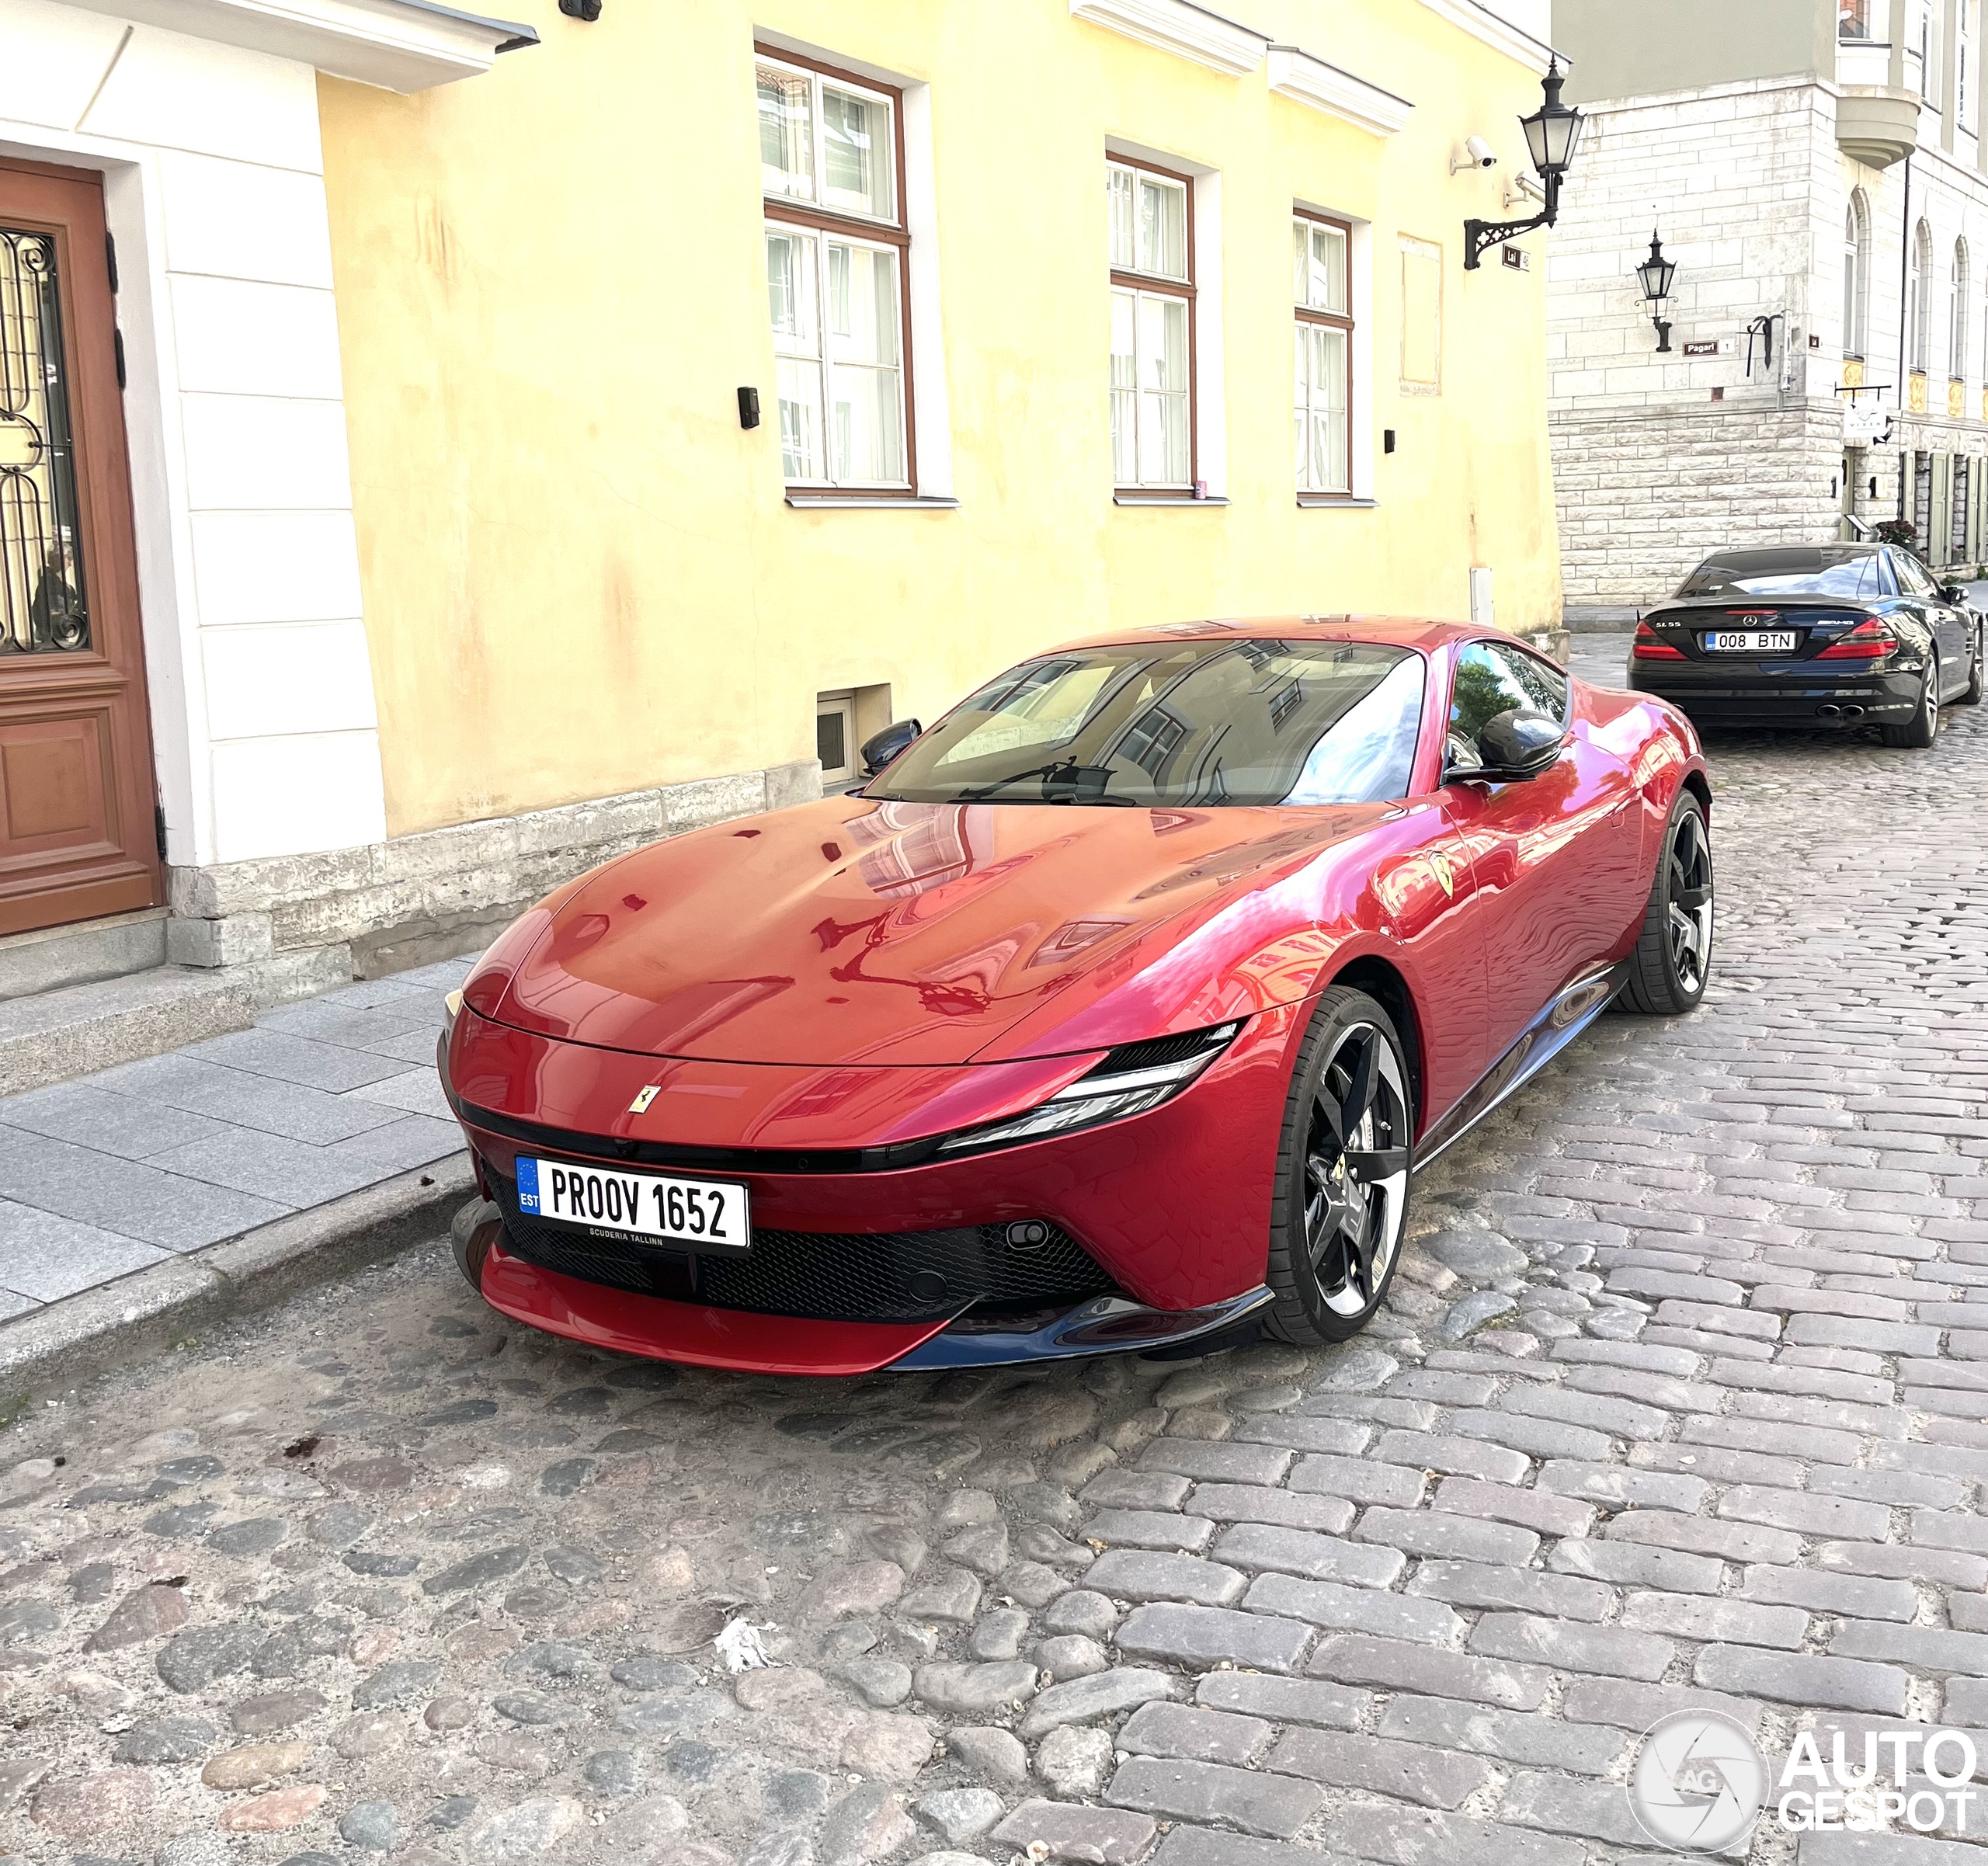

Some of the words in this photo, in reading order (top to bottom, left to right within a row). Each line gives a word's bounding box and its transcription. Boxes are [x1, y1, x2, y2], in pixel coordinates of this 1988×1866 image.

[1507, 250, 1517, 263] Lai
[1687, 342, 1715, 353] Pagari
[1719, 634, 1746, 648] 008
[1758, 634, 1790, 648] BTN
[520, 1193, 540, 1208] EST
[551, 1168, 639, 1225] PROOV
[652, 1183, 727, 1238] 1652
[589, 1227, 628, 1242] SCUDERIA
[630, 1233, 663, 1246] TALLINN
